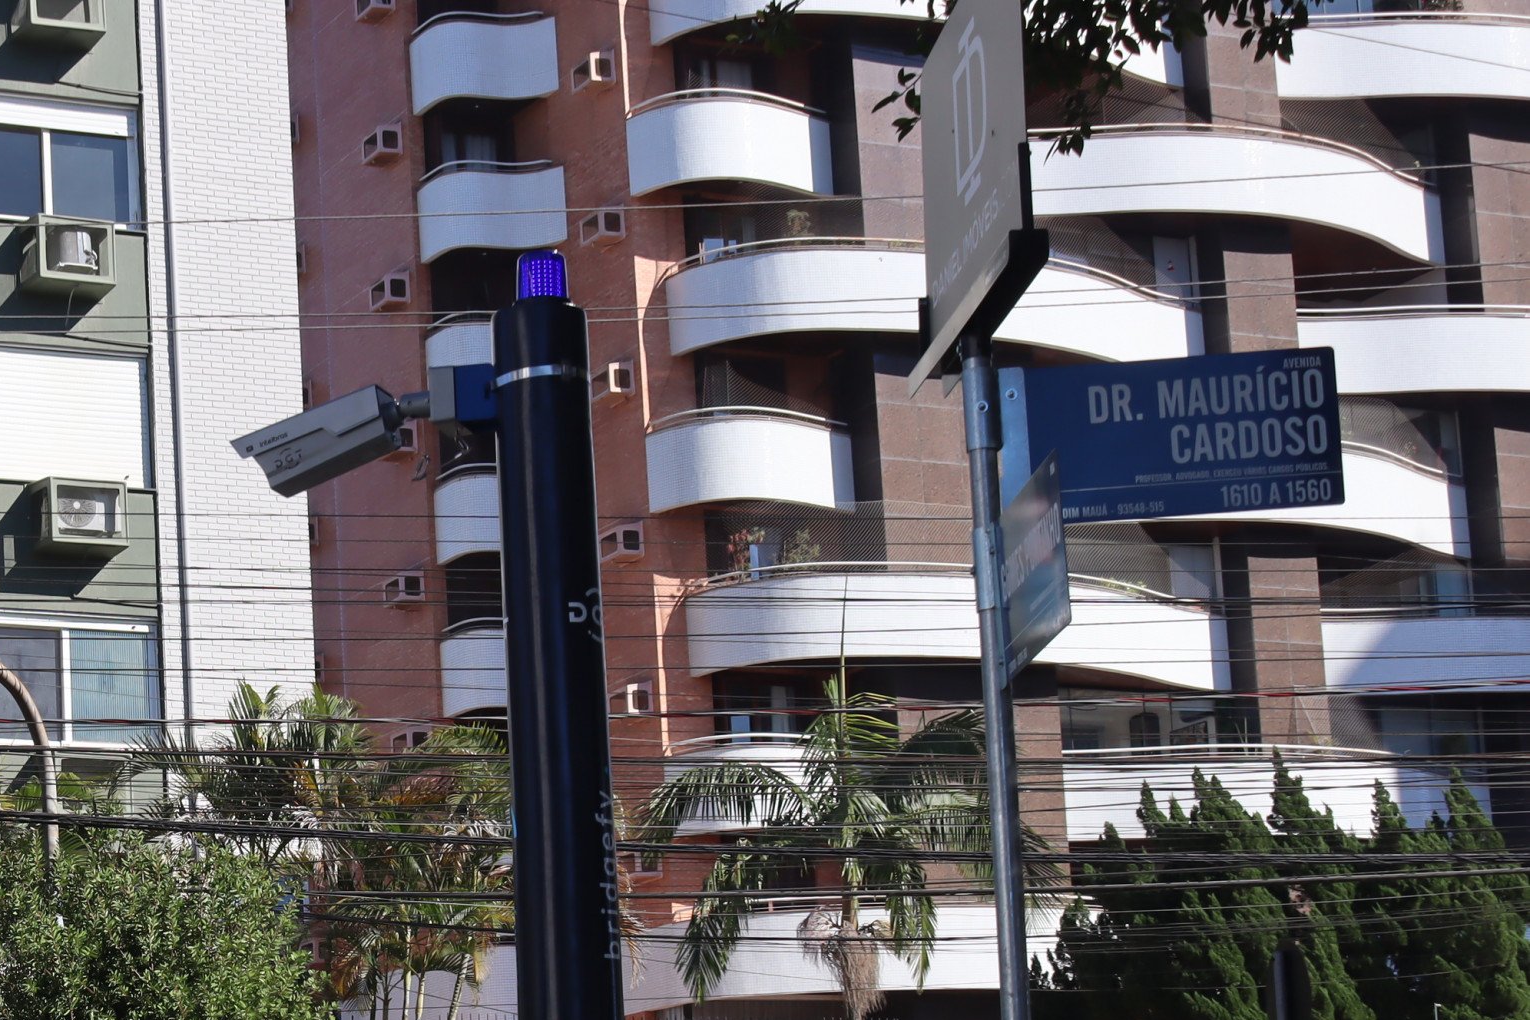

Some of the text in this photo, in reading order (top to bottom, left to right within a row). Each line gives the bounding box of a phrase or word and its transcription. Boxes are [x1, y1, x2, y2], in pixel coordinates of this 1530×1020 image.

[1282, 355, 1322, 369] AVENIDA
[1087, 364, 1324, 424] DR. MAURÍCIO
[1170, 414, 1328, 464] CARDOSO
[1220, 478, 1331, 507] 1610 A 1560
[1062, 506, 1080, 519] DIM
[1082, 503, 1108, 517] MAUÁ
[1117, 501, 1164, 515] 93548-515
